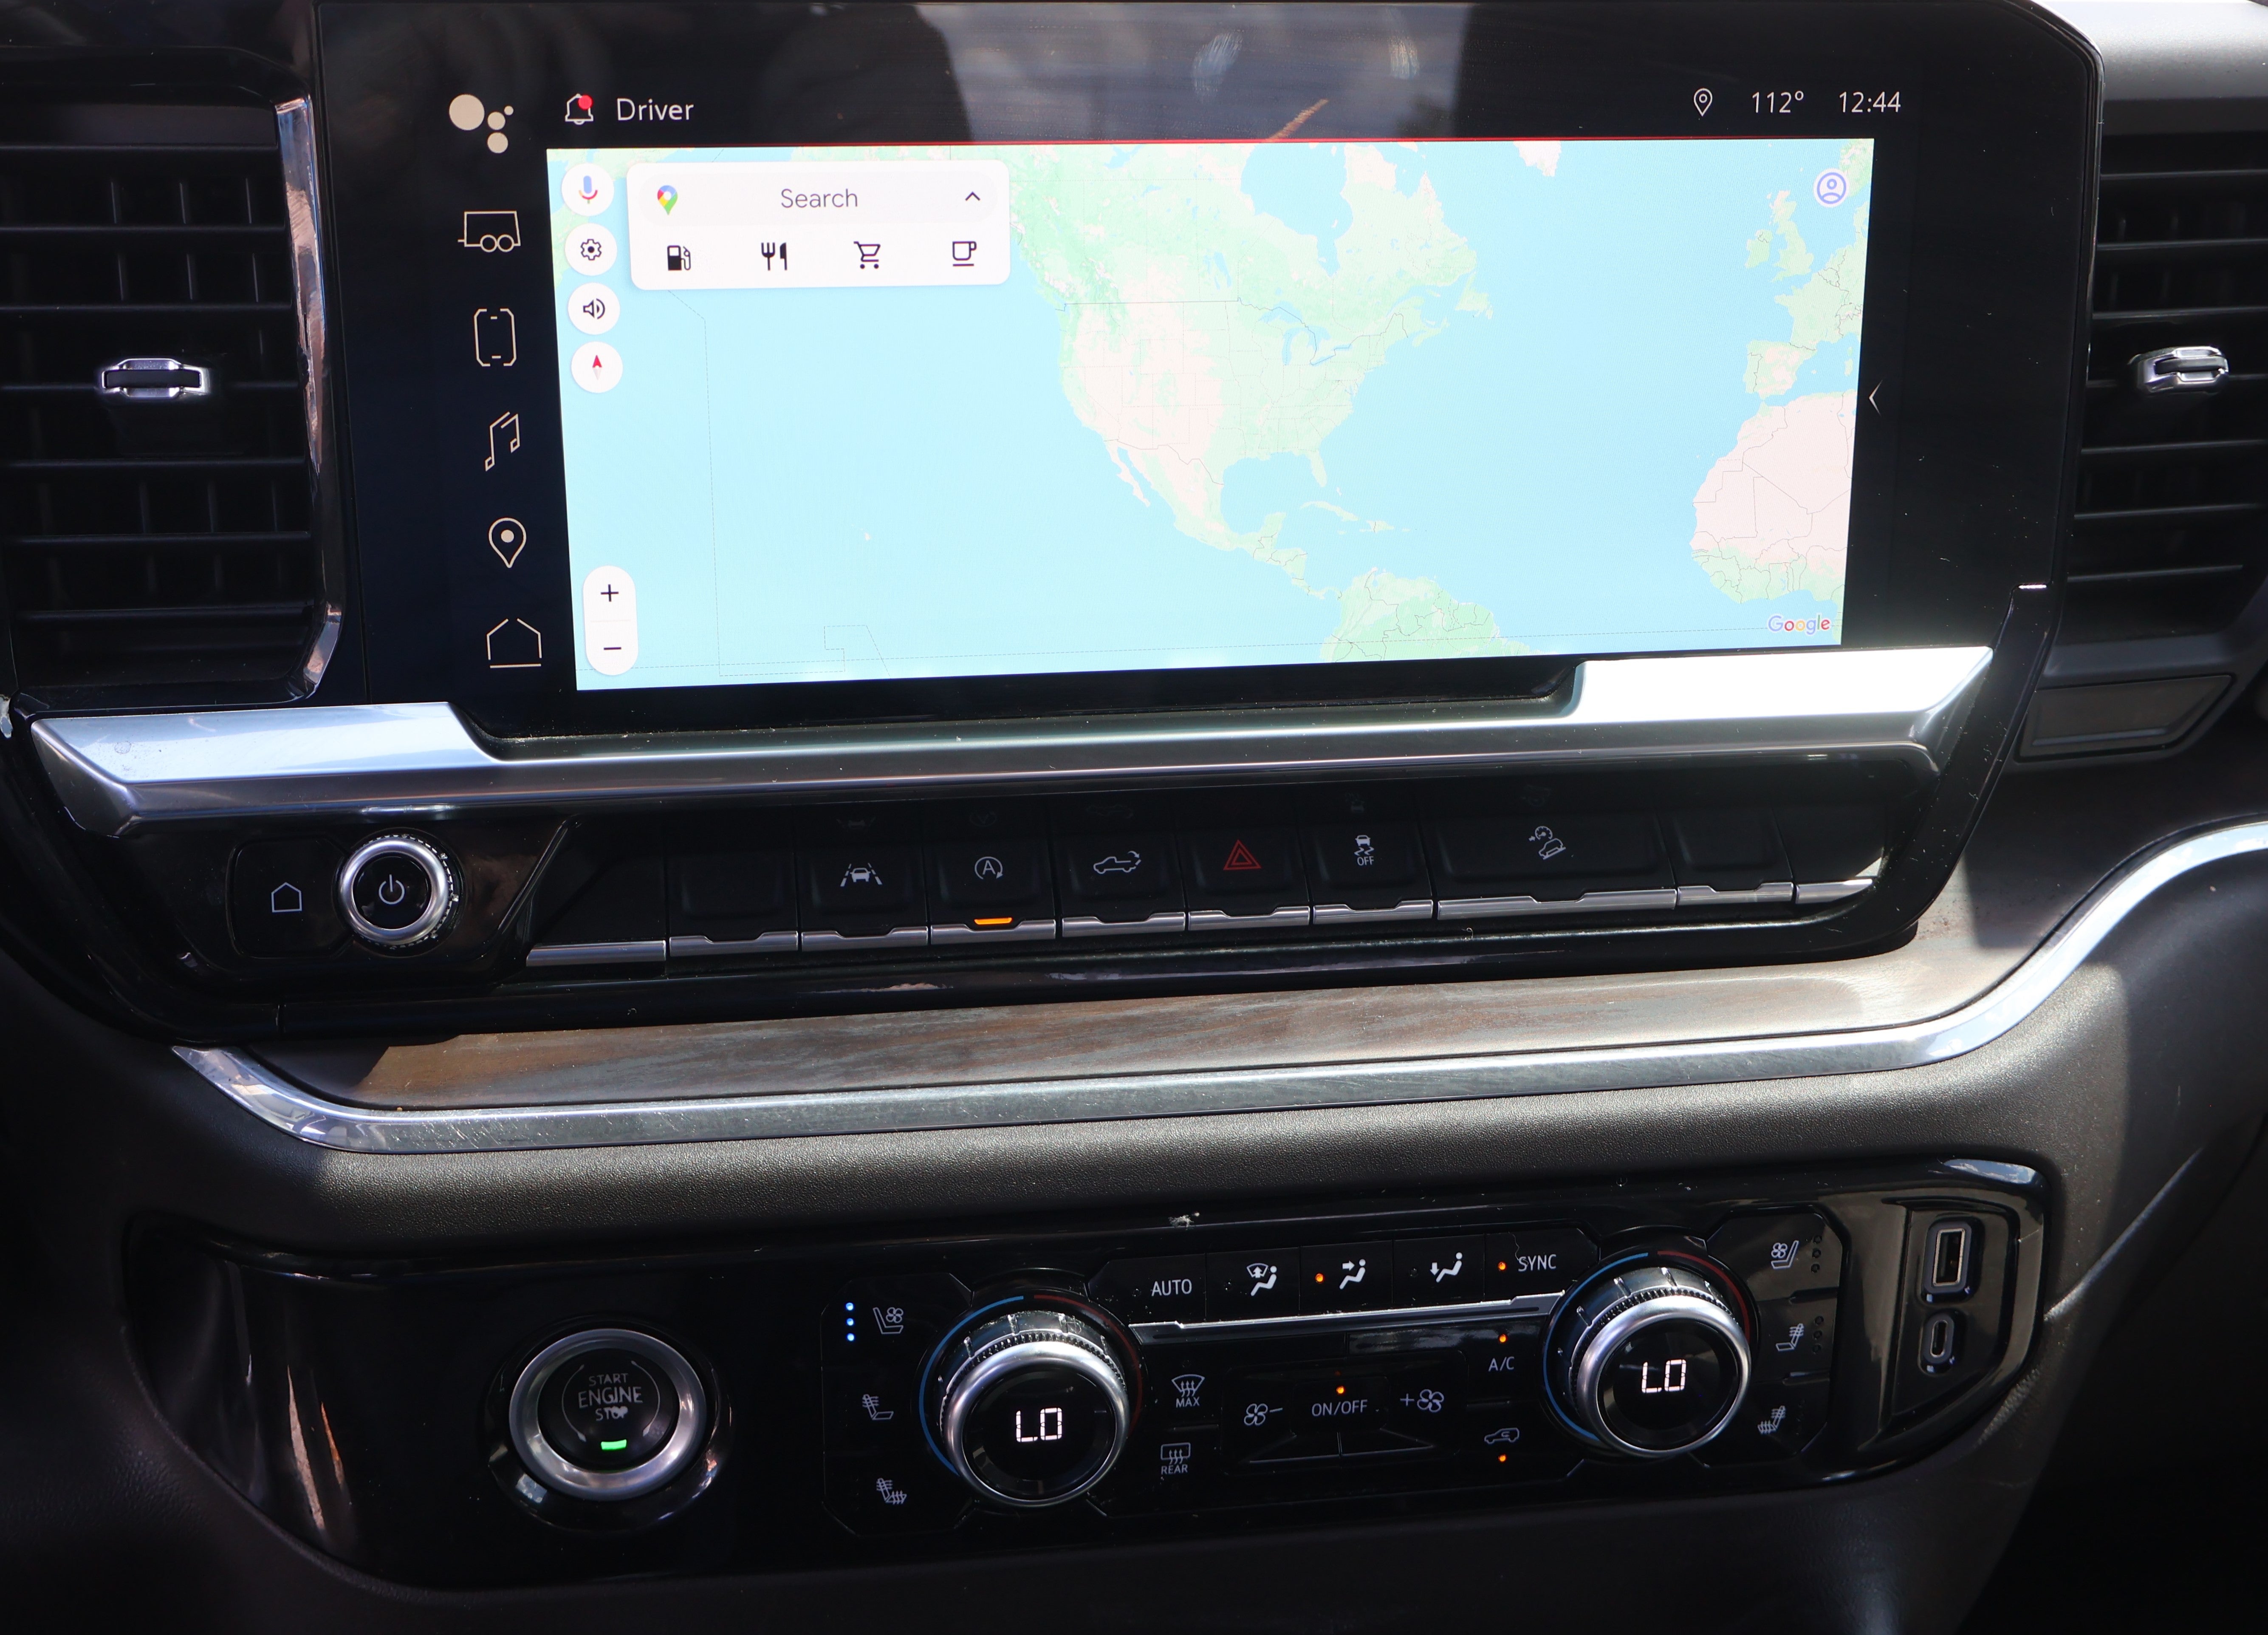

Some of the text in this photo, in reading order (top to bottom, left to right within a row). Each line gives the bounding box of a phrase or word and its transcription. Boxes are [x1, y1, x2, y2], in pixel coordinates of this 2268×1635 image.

[616, 98, 695, 122] Driver
[1839, 91, 1901, 113] 12:44
[780, 187, 859, 209] Search
[1768, 614, 1830, 635] Google
[1357, 856, 1375, 866] OFF
[1517, 1253, 1557, 1273] SYNC
[1151, 1279, 1193, 1297] AUTO
[1488, 1356, 1515, 1373] A/C
[588, 1373, 629, 1387] START
[1640, 1358, 1687, 1395] LO
[578, 1386, 644, 1409] ENGINE
[1175, 1397, 1200, 1408] MAX
[595, 1406, 628, 1421] STOP
[1311, 1399, 1369, 1417] ON/OFF
[1015, 1407, 1063, 1443] LO
[1161, 1463, 1189, 1474] REAR
